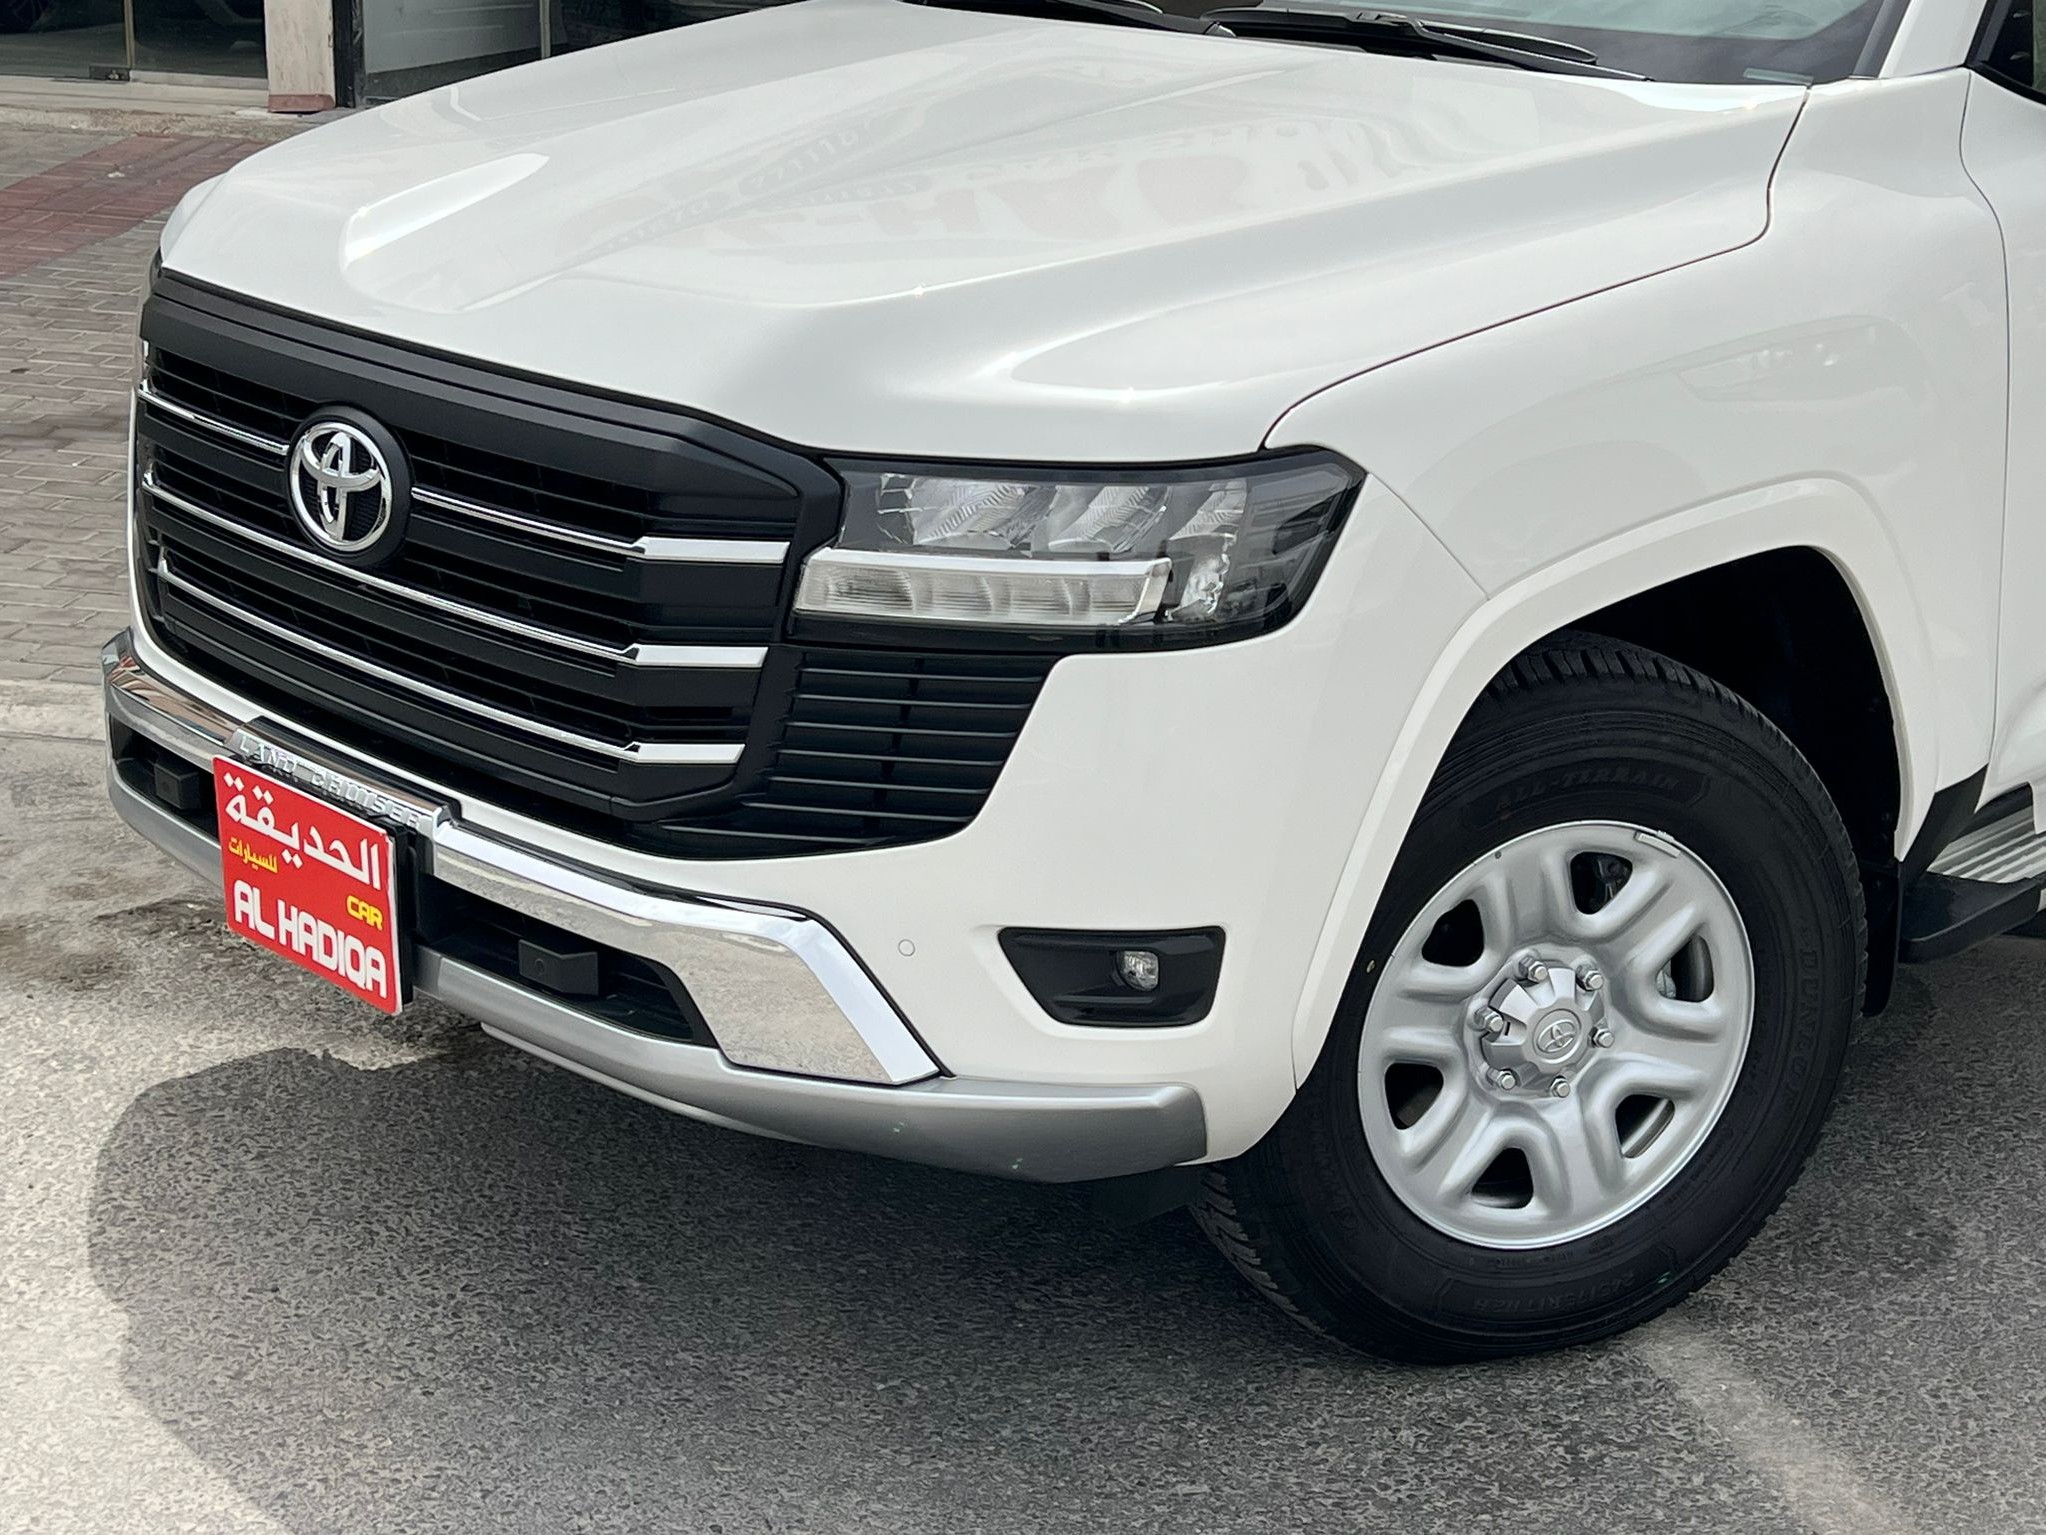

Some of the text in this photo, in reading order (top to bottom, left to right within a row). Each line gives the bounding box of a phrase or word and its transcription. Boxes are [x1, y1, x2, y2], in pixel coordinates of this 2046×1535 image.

[224, 773, 381, 890] الحديقة
[228, 837, 279, 873] للسيارات
[233, 879, 388, 999] AL HADIQA
[346, 895, 383, 930] CAR
